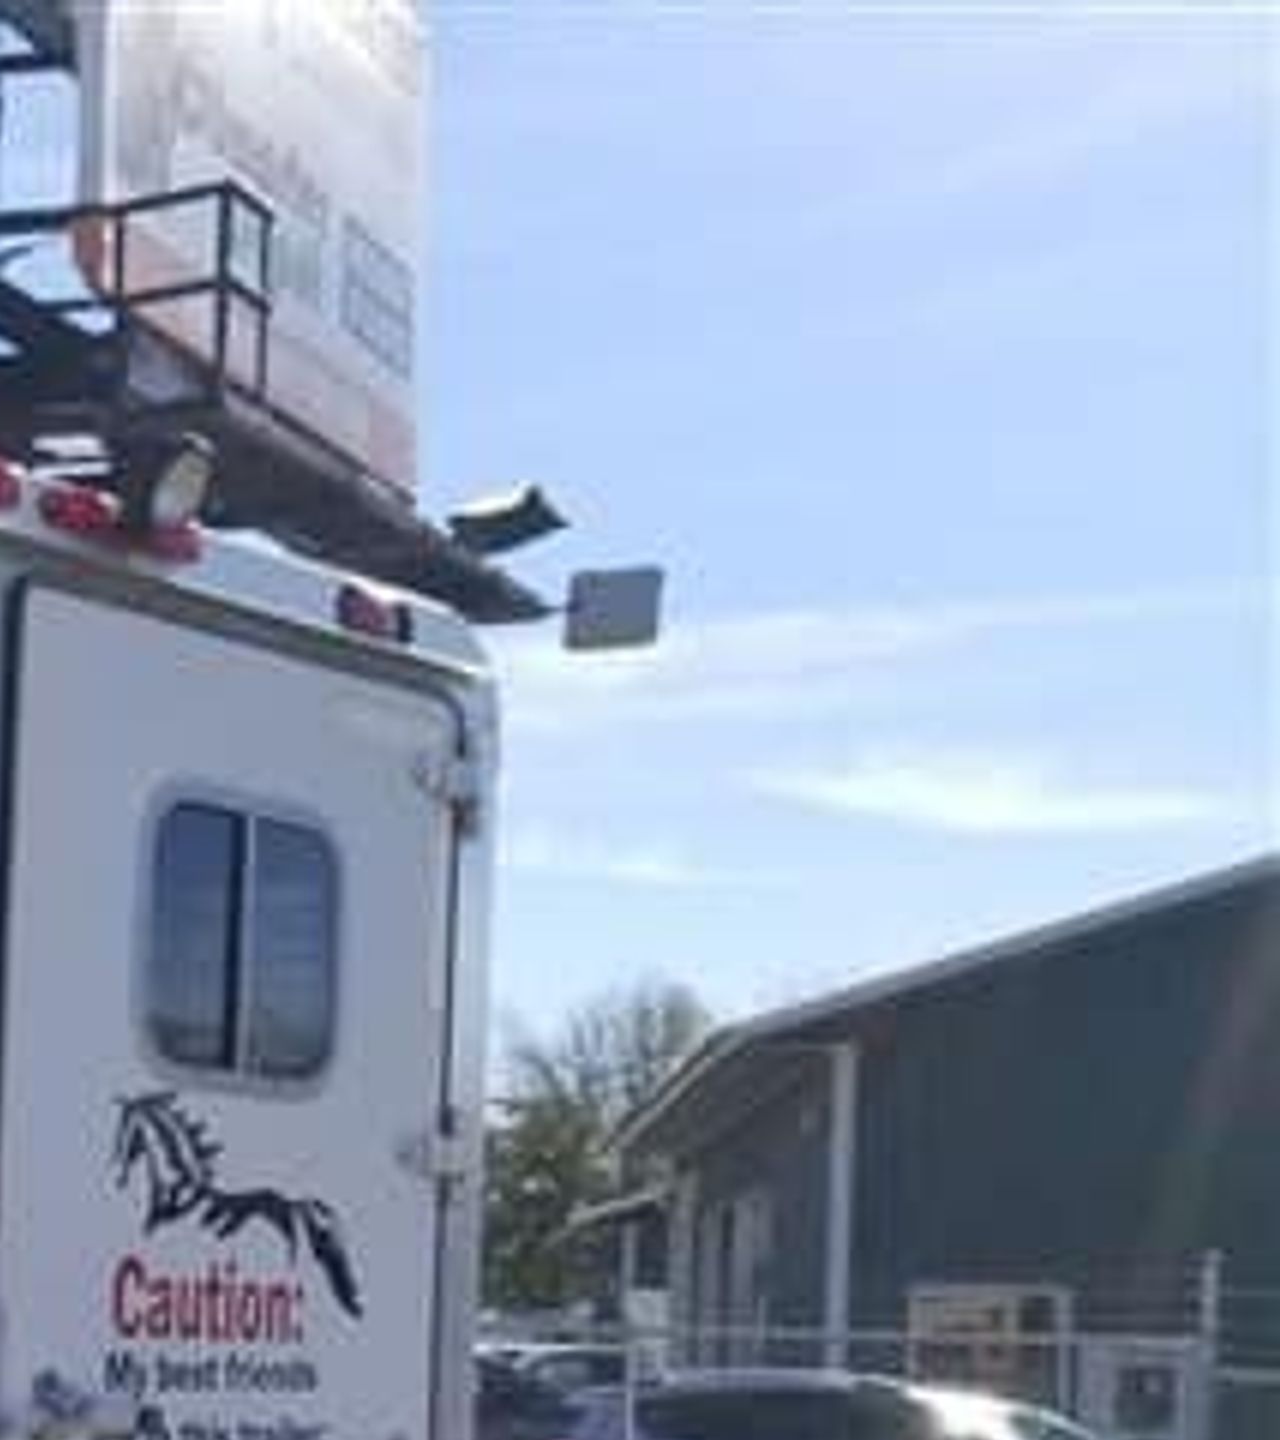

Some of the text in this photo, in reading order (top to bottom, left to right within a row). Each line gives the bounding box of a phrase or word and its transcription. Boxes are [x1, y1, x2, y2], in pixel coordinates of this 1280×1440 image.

[114, 1255, 304, 1343] Caution:
[104, 1351, 319, 1399] My best friends
